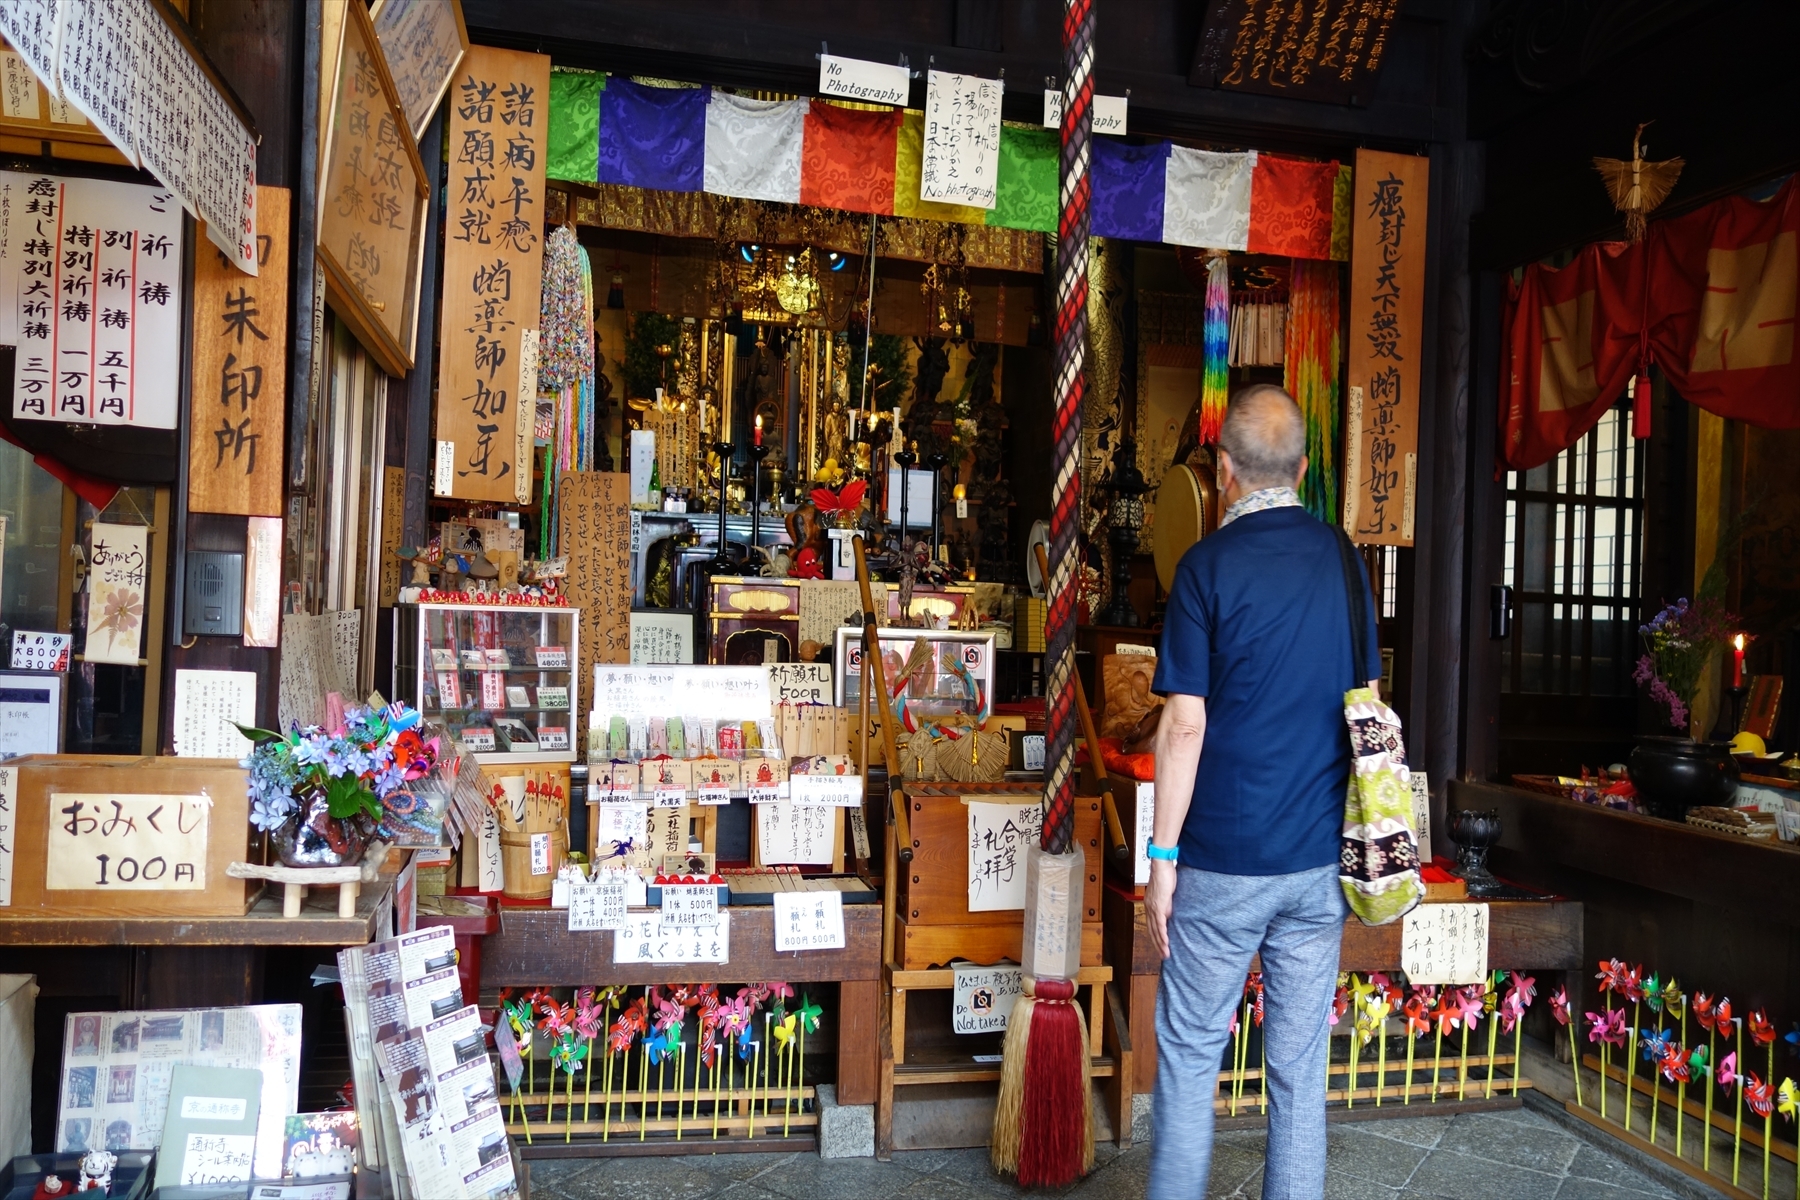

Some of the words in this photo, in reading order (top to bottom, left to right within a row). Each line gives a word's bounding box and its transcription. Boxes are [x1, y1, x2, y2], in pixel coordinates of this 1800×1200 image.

[826, 62, 842, 76] No
[826, 79, 904, 103] Photography
[946, 74, 963, 179] カメラはおひかえ
[963, 91, 978, 149] 場です
[453, 75, 497, 246] 諸願成就
[494, 82, 538, 254] 諸病平癒
[924, 184, 944, 198] No
[22, 178, 58, 340] 癌封じ特別大祈祷
[138, 193, 174, 306] ご祈祷
[61, 225, 95, 323] 特別祈祷
[99, 230, 132, 330] 別祈祷
[20, 356, 50, 416] 三万円
[59, 350, 89, 416] 一万円
[98, 350, 129, 418] 五千円
[92, 539, 144, 571] ありがとう
[104, 568, 145, 590] ございます
[17, 633, 63, 647] 清め砂
[15, 647, 22, 655] 大
[26, 647, 68, 657] 800円
[13, 658, 22, 666] 小
[25, 660, 67, 670] 300円
[770, 665, 830, 685] 祈願札
[779, 687, 821, 702] 500円
[601, 795, 632, 803] お稲荷さん
[659, 798, 681, 806] 大黒天
[820, 793, 850, 803] 2000円
[61, 800, 202, 837] おみくじ
[1018, 807, 1031, 846] 脱帽
[971, 814, 984, 902] しましょう
[983, 829, 1002, 893] 礼拝
[1001, 818, 1021, 883] 合掌
[95, 854, 195, 885] 100円
[572, 887, 592, 895] お願い
[664, 887, 682, 895] お願い
[573, 899, 580, 908] 大
[603, 896, 624, 907] 500円
[690, 900, 713, 909] 500円
[572, 910, 580, 918] 小
[603, 908, 624, 918] 400円
[784, 936, 808, 946] 800円
[813, 934, 836, 944] 500円
[637, 942, 721, 960] 風ぐるまを
[956, 1005, 968, 1015] Do
[956, 1015, 977, 1031] Not
[979, 1016, 999, 1029] take
